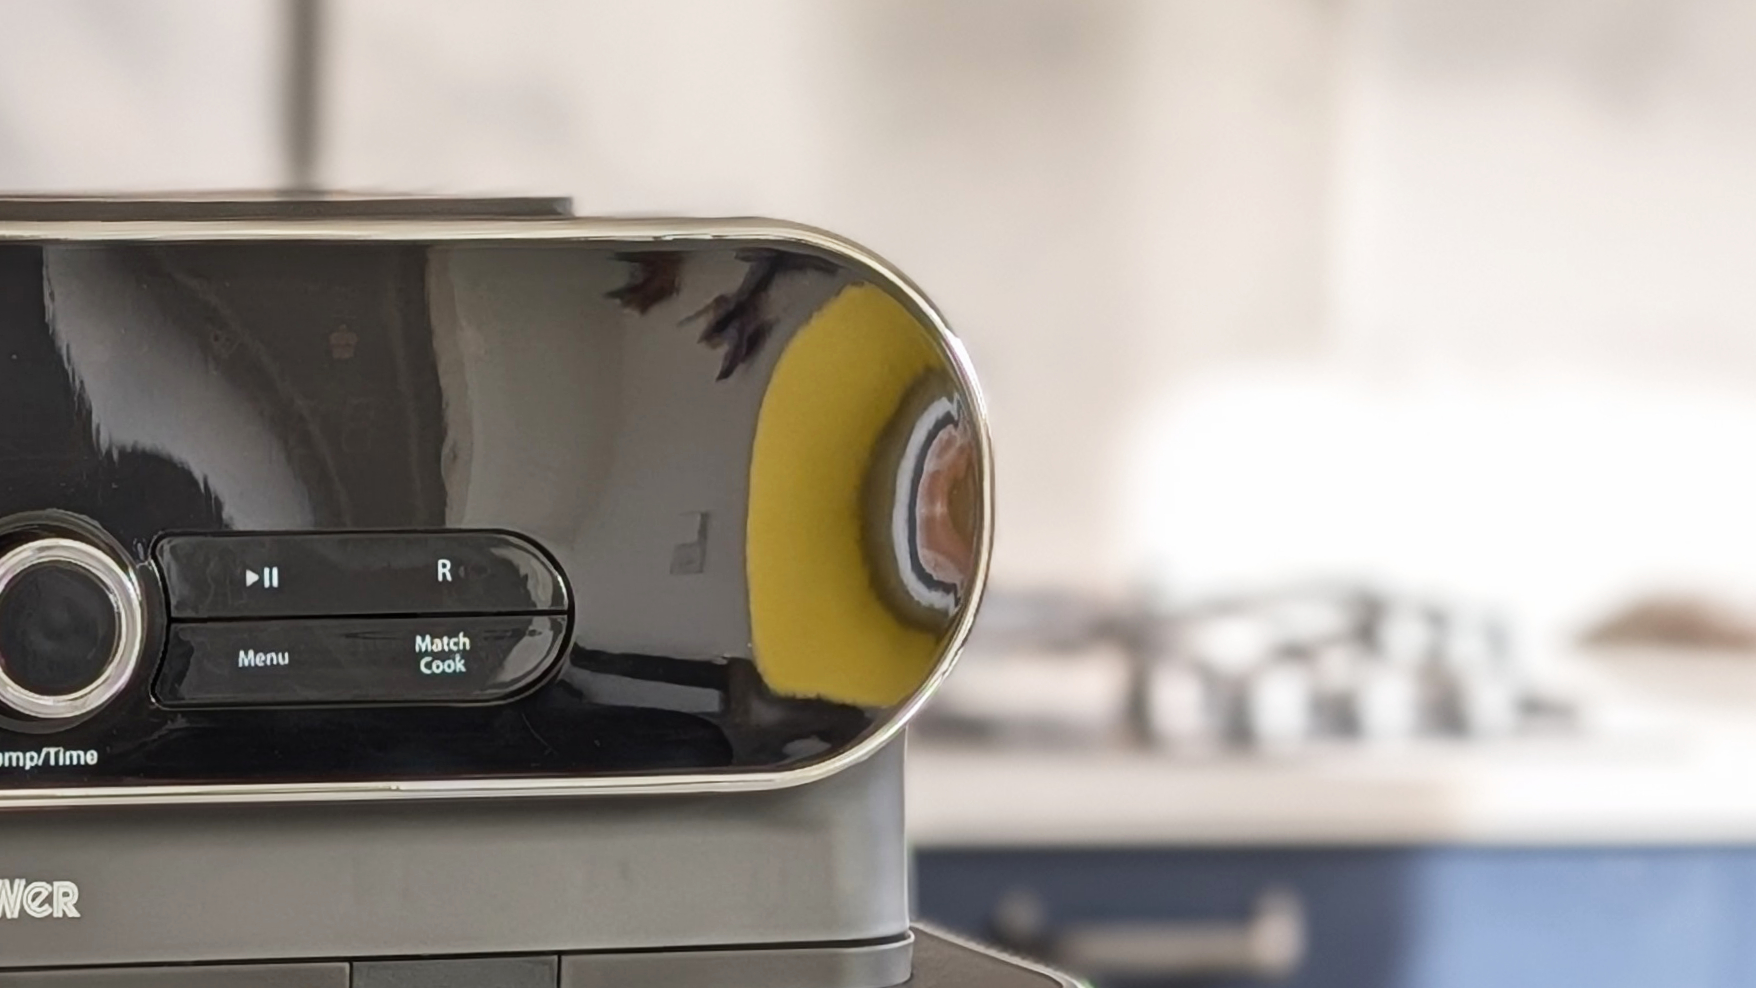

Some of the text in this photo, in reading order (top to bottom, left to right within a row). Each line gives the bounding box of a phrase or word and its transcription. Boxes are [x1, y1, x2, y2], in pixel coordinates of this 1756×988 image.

[437, 559, 453, 582] R
[415, 631, 471, 653] Match
[238, 650, 290, 668] Menu
[419, 653, 467, 675] Cook
